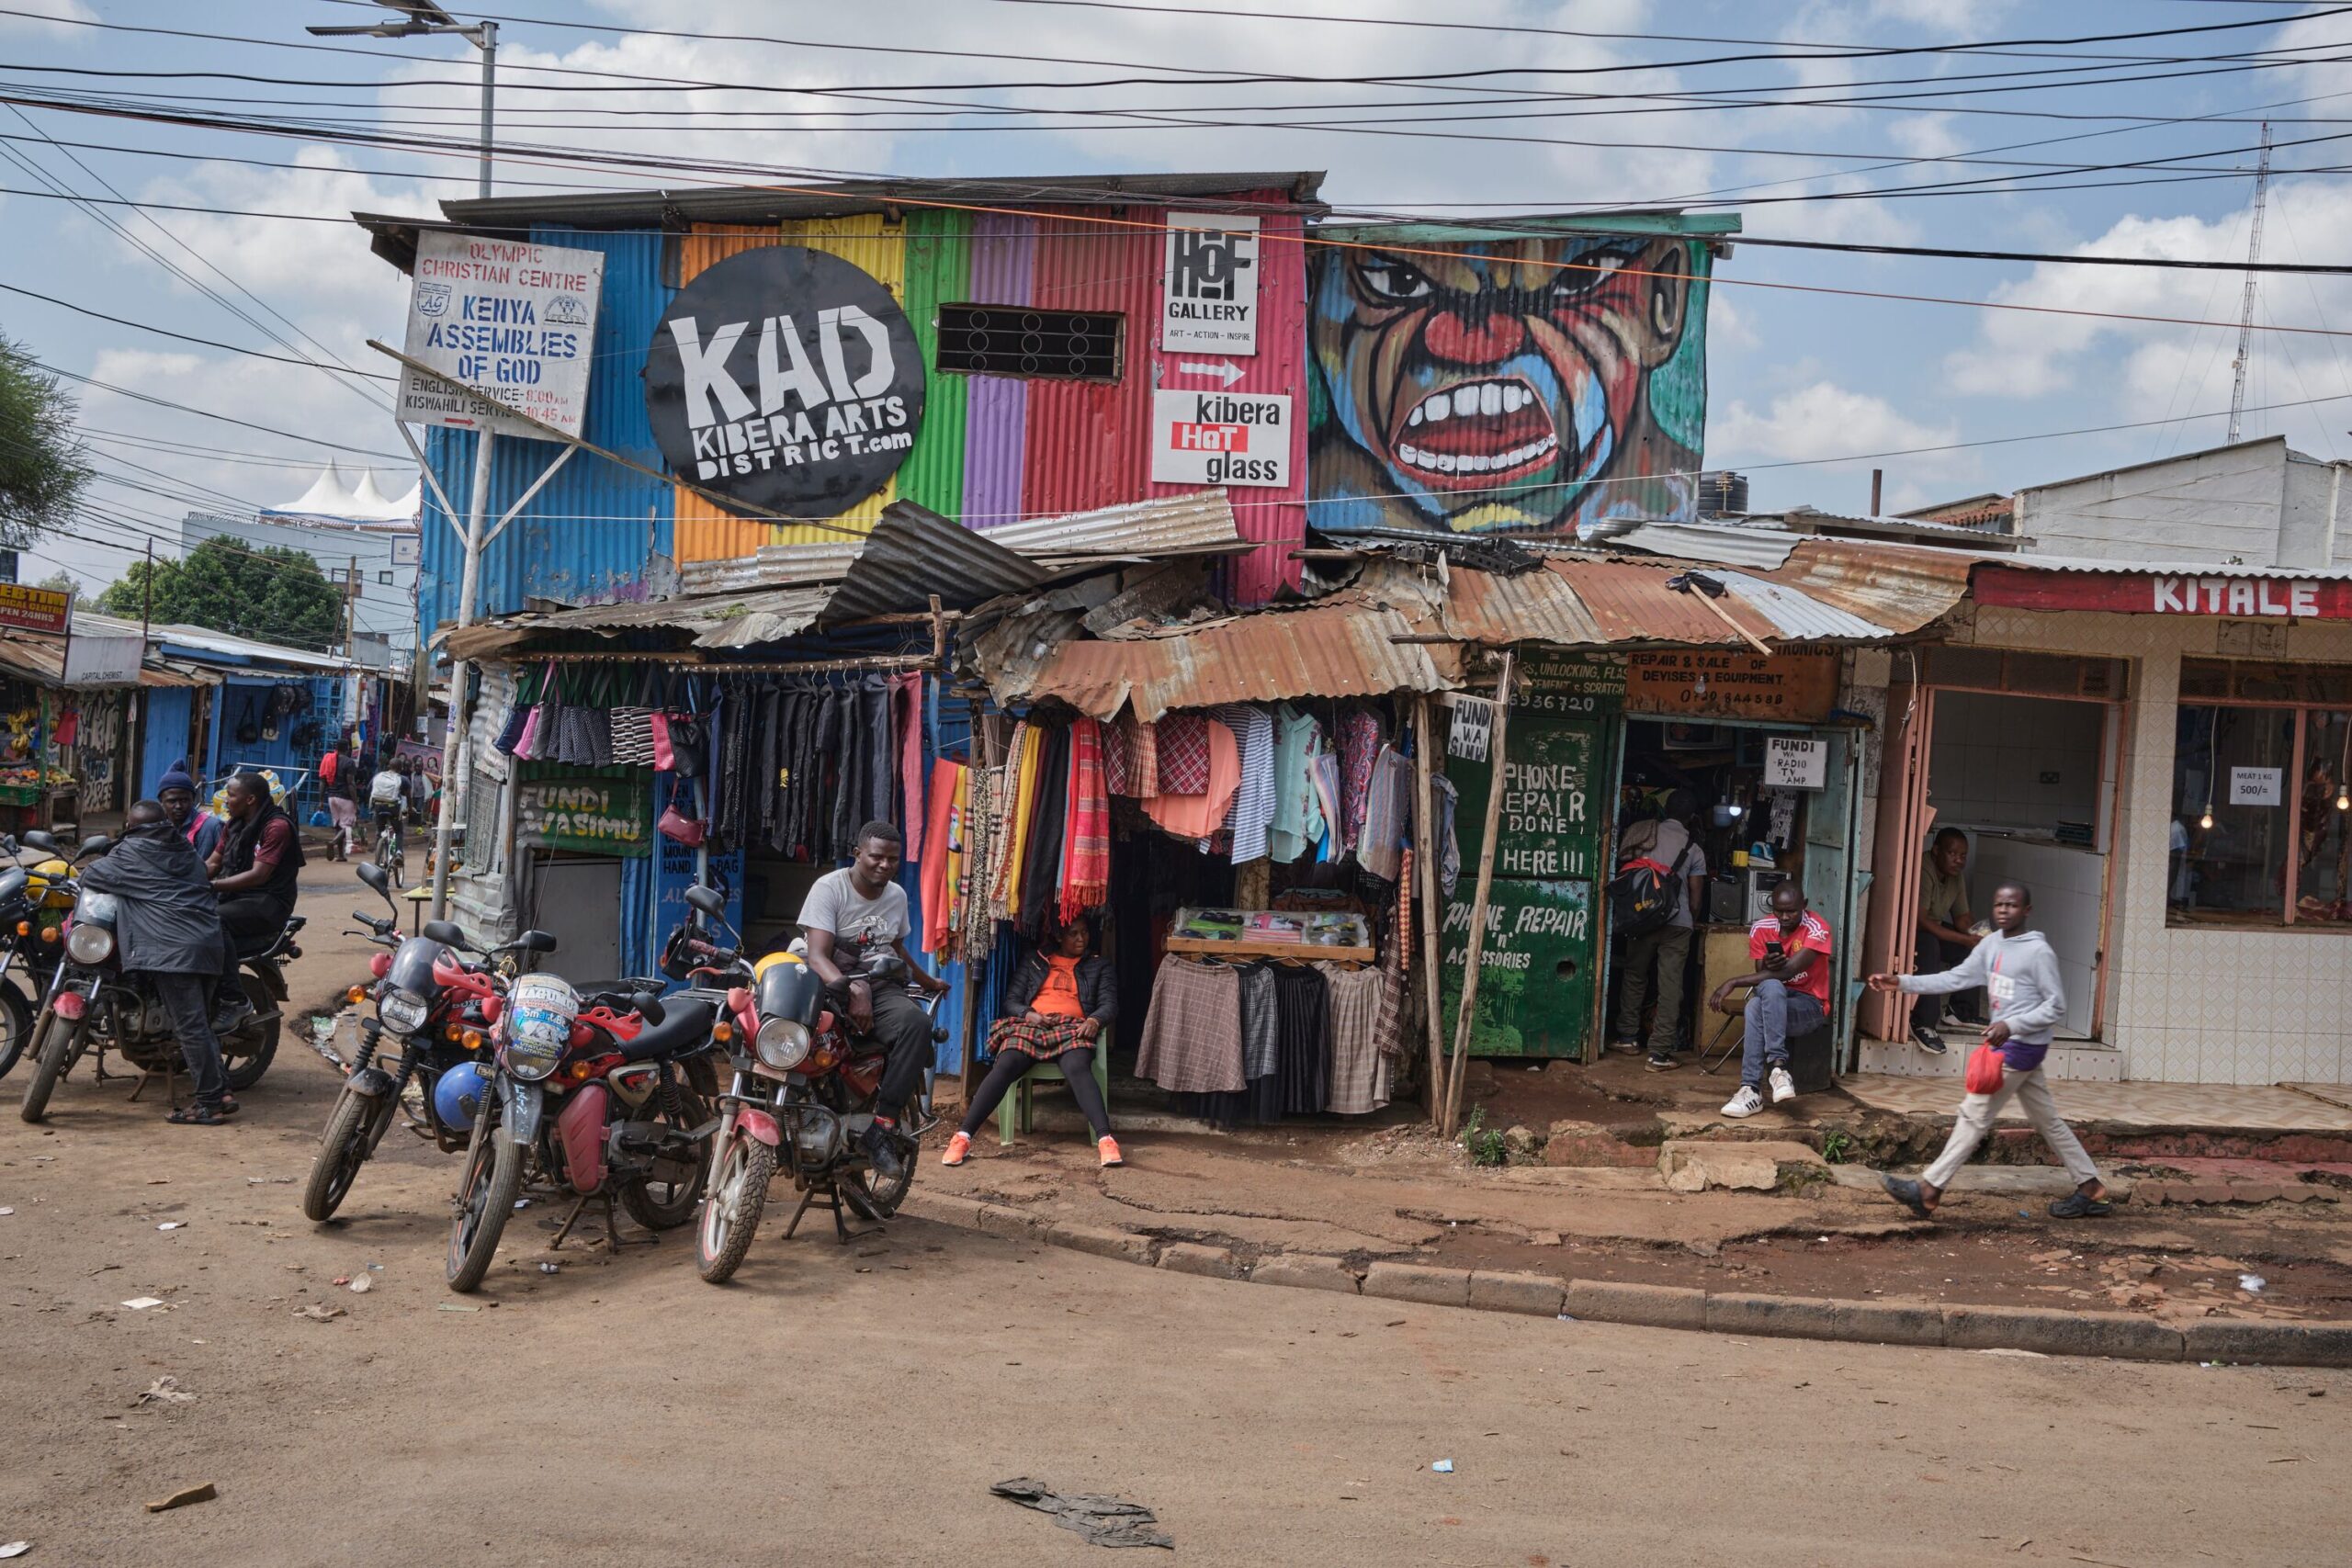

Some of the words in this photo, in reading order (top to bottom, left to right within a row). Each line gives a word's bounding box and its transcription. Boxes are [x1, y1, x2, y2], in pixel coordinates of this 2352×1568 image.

[469, 243, 543, 264] OLYMPIC
[1172, 229, 1252, 301] HOF
[423, 259, 510, 284] CHRISTIAN
[519, 269, 587, 292] CENTRE
[463, 295, 536, 325] KENYA
[1169, 302, 1250, 321] GALLERY
[426, 323, 577, 358] ASSEMBLIES
[1170, 330, 1184, 338] ART
[1193, 331, 1219, 340] ACTION
[1227, 332, 1250, 342] INSPIRE
[459, 355, 487, 381] OF
[496, 358, 540, 385] GOD
[668, 305, 895, 429] KAD
[405, 395, 465, 413] KISWAHILI
[1196, 394, 1280, 425] kibera
[692, 412, 817, 459] KIBERA
[826, 396, 907, 437] ARTS
[1206, 450, 1278, 483] glass
[29, 602, 64, 615] CENTRE
[2154, 577, 2320, 616] KITALE
[82, 671, 101, 681] CAPITAL
[102, 671, 123, 680] CHEMIST
[1540, 662, 1601, 680] UNLOCKING,
[1631, 653, 1678, 669] REPAIR
[1683, 656, 1692, 668] &
[1697, 656, 1731, 669] SALE
[1750, 660, 1768, 671] OF
[1583, 681, 1626, 696] SCRATCH
[1642, 670, 1696, 683] DEVISES
[1453, 699, 1493, 729] FUNDI
[1463, 726, 1481, 745] WA
[1772, 739, 1815, 752] FUNDI
[1503, 762, 1577, 793] PHONE
[2240, 785, 2269, 796] 500/=
[519, 786, 610, 814] FUNDI
[1499, 791, 1587, 822] EPAIR
[663, 860, 691, 874] HAND
[1503, 848, 1584, 876] HERE!!!
[1442, 901, 1507, 933] PHNE
[1515, 905, 1589, 942] REPAIR
